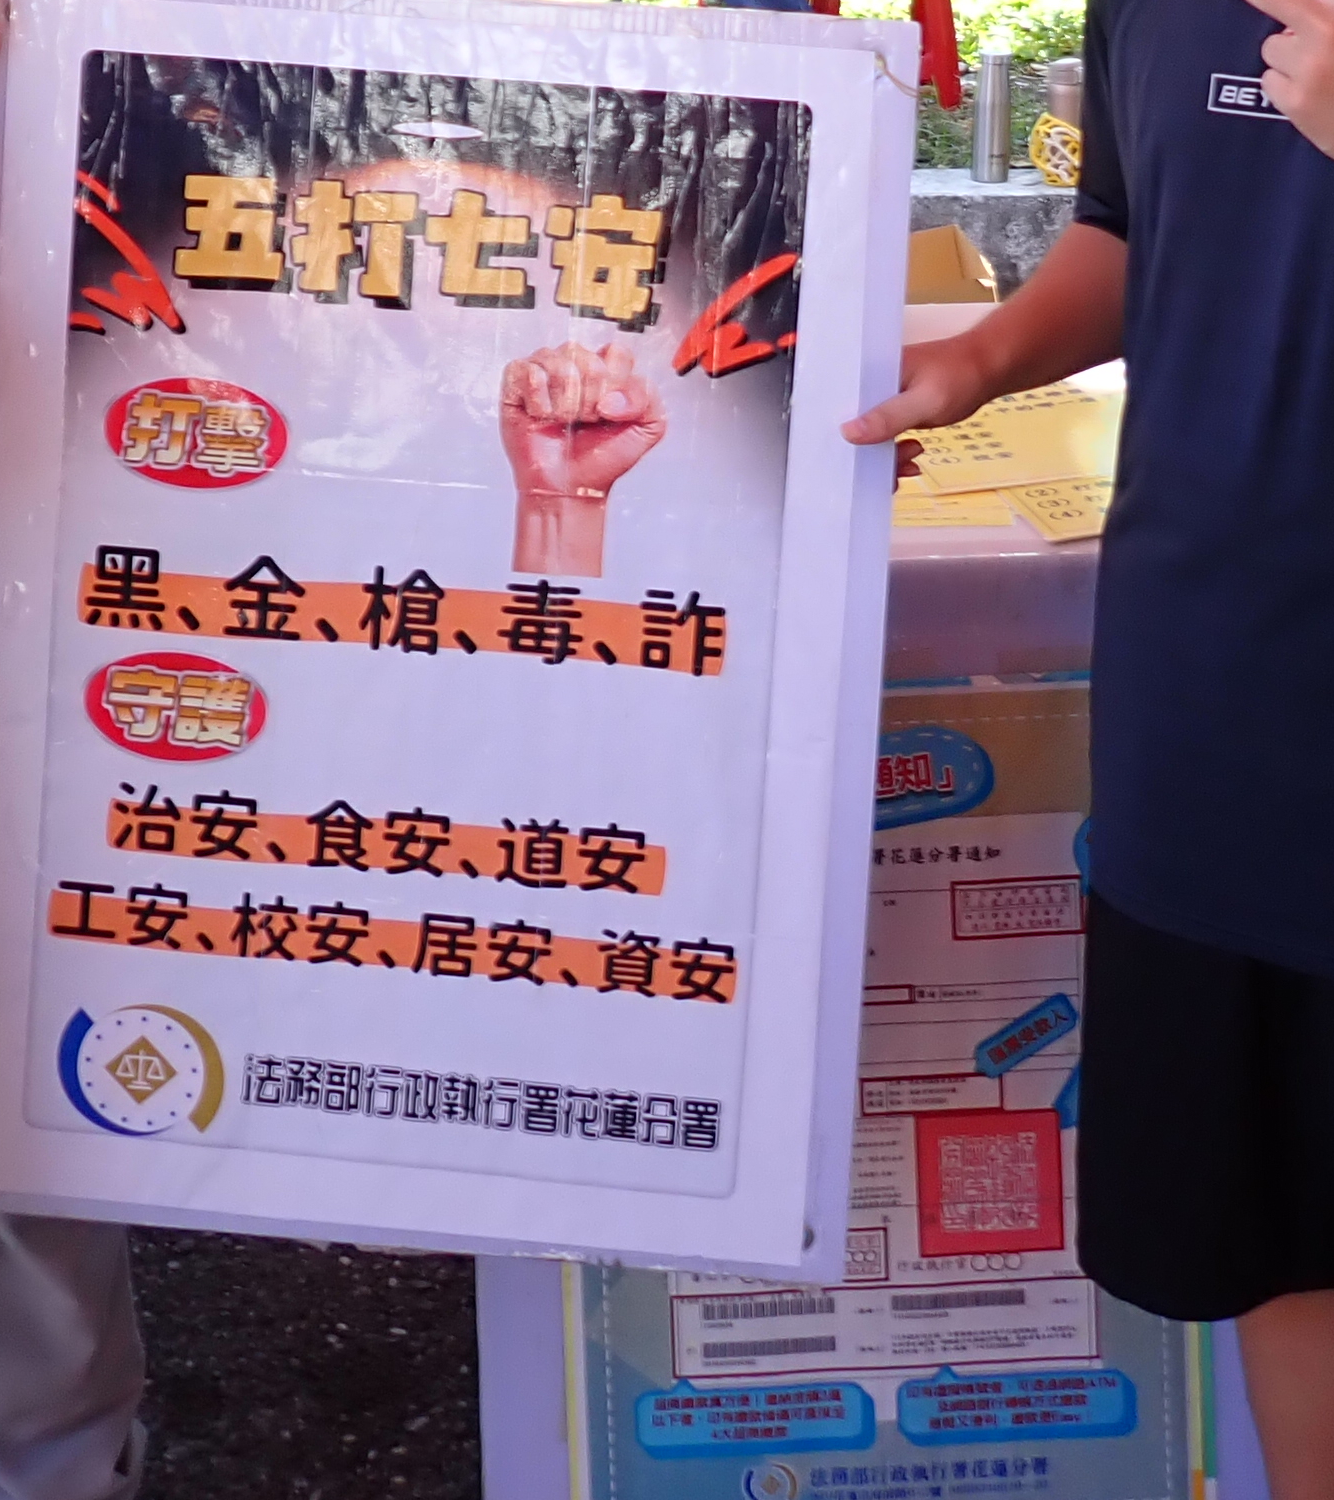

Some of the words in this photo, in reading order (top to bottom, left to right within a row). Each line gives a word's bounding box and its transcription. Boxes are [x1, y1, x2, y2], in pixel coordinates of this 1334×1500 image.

[174, 173, 666, 326] 五打七安
[122, 389, 270, 477] 打擊
[83, 544, 727, 676] 黑、金、槍、毒、詐
[105, 668, 252, 748] 守護
[112, 781, 647, 895] 治安、食安、道安
[51, 879, 738, 1004] 工安、校安、居安、資安
[241, 1052, 722, 1152] 法務部行政執行署花蓮分署
